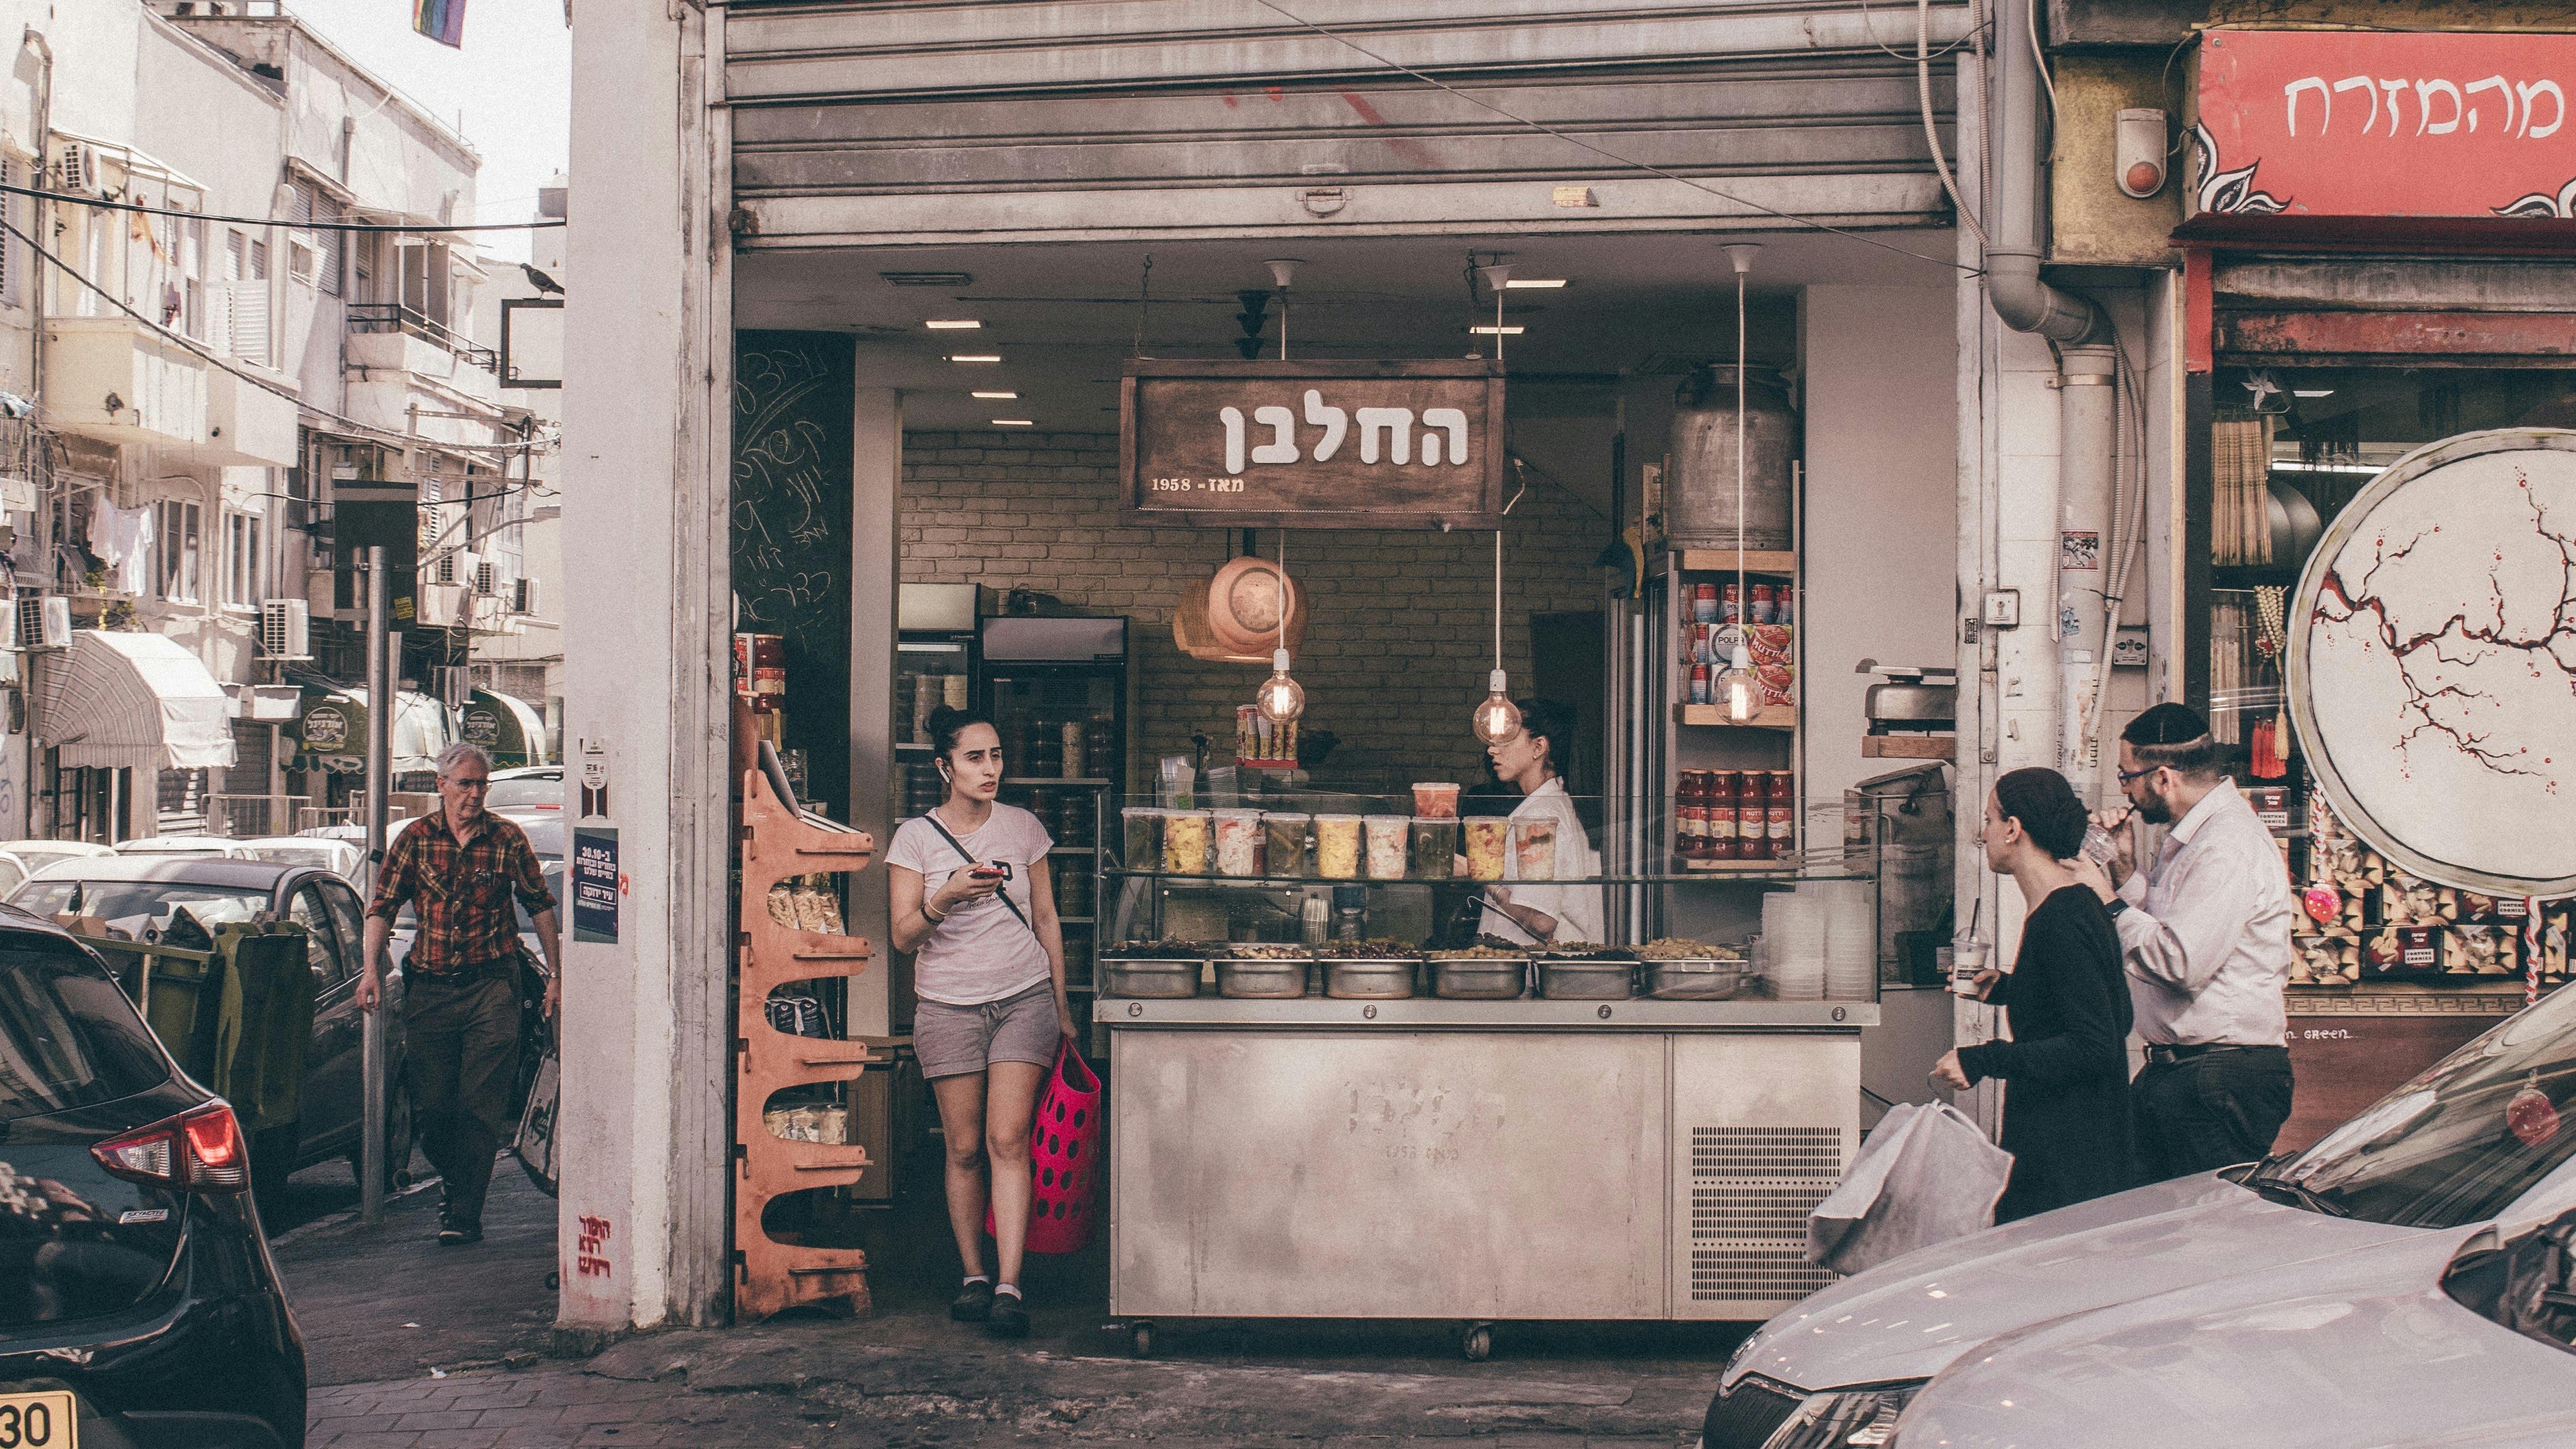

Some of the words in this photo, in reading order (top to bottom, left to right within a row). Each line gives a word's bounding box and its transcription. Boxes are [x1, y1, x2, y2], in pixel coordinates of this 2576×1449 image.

[2284, 75, 2565, 138] מהמזרח
[1219, 389, 1468, 475] החלבן
[1152, 478, 1192, 492] 1958
[1752, 638, 1781, 657] MUTTI
[602, 889, 613, 900] עיר
